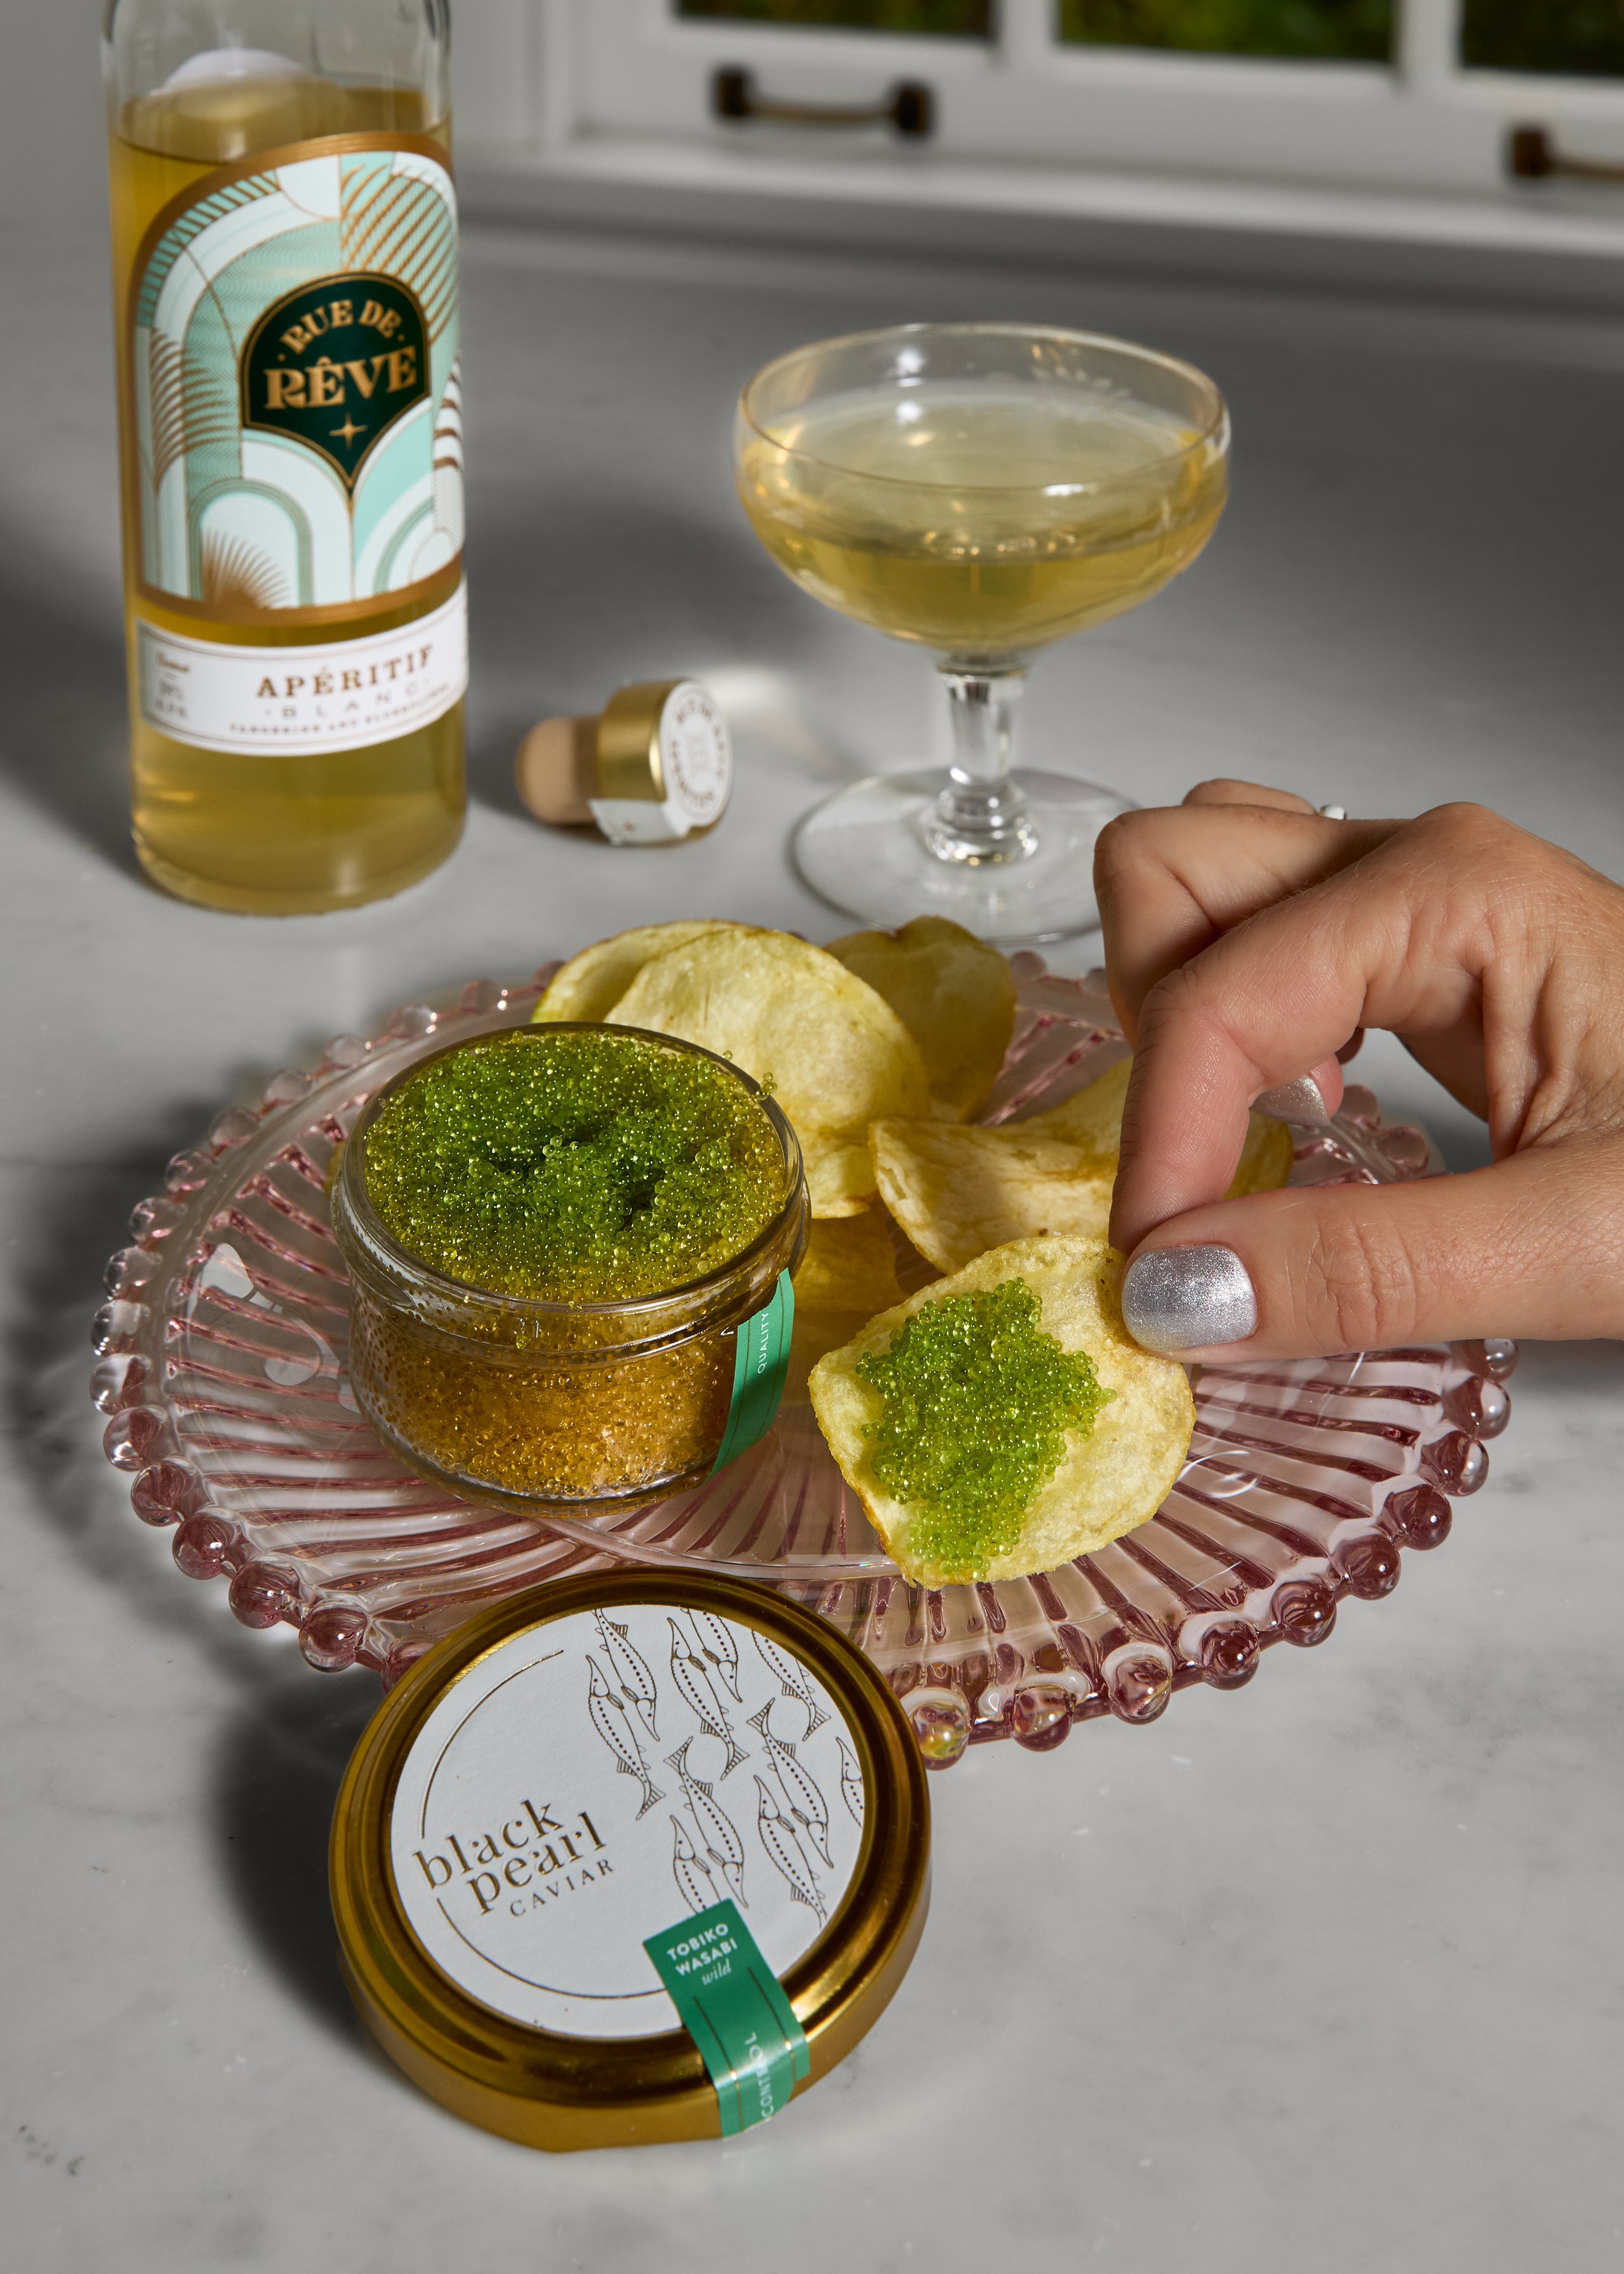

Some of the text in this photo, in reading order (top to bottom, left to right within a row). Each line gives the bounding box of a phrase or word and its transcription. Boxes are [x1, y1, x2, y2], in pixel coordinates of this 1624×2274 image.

[279, 299, 402, 354] RUE DE
[263, 345, 418, 410] RÊVE
[256, 644, 433, 698] APÉRITIF
[281, 681, 419, 719] BLANC
[757, 1312, 769, 1374] QUALITY
[412, 1799, 564, 1889] black
[466, 1811, 607, 1915] pearl
[510, 1859, 613, 1917] CAVIAR
[666, 1923, 728, 1962] TOBIKO
[675, 1938, 738, 1976] WASABI
[701, 1958, 731, 1986] wild
